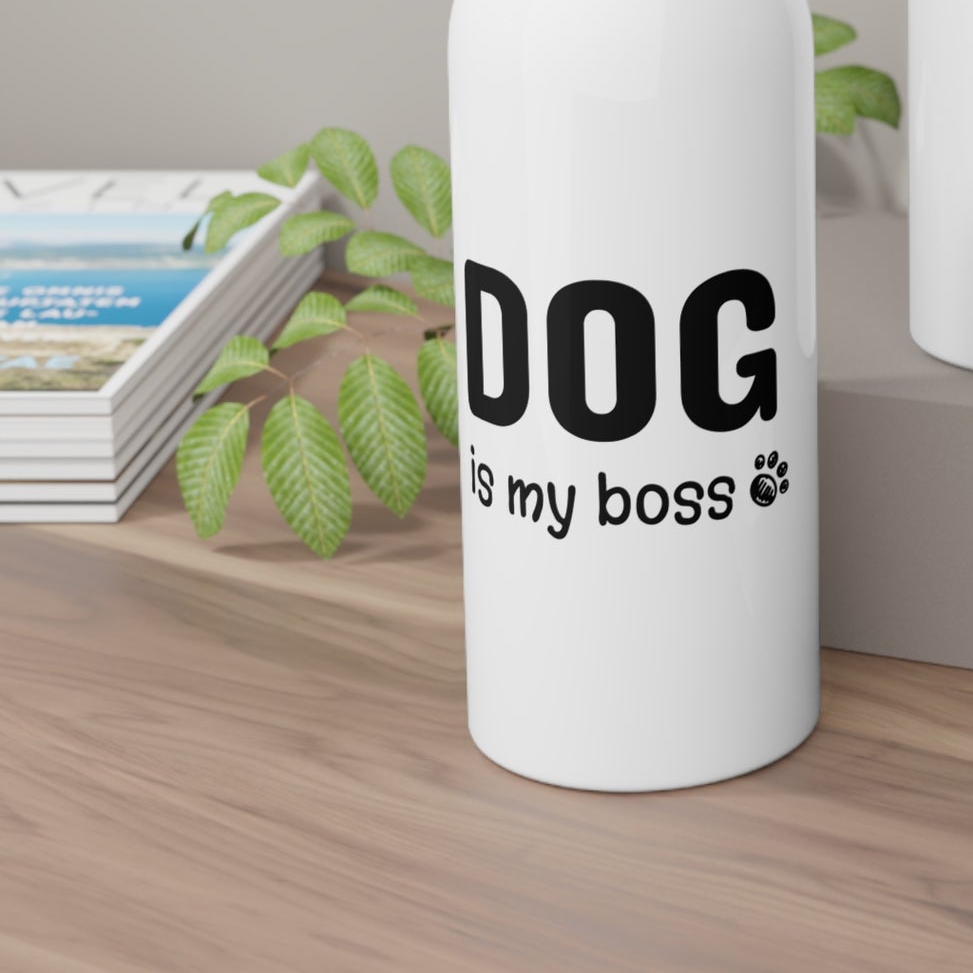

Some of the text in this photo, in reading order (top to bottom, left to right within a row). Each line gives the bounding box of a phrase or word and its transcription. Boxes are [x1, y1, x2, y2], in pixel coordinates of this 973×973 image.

[464, 258, 778, 442] DOG
[470, 444, 736, 540] is my boss
